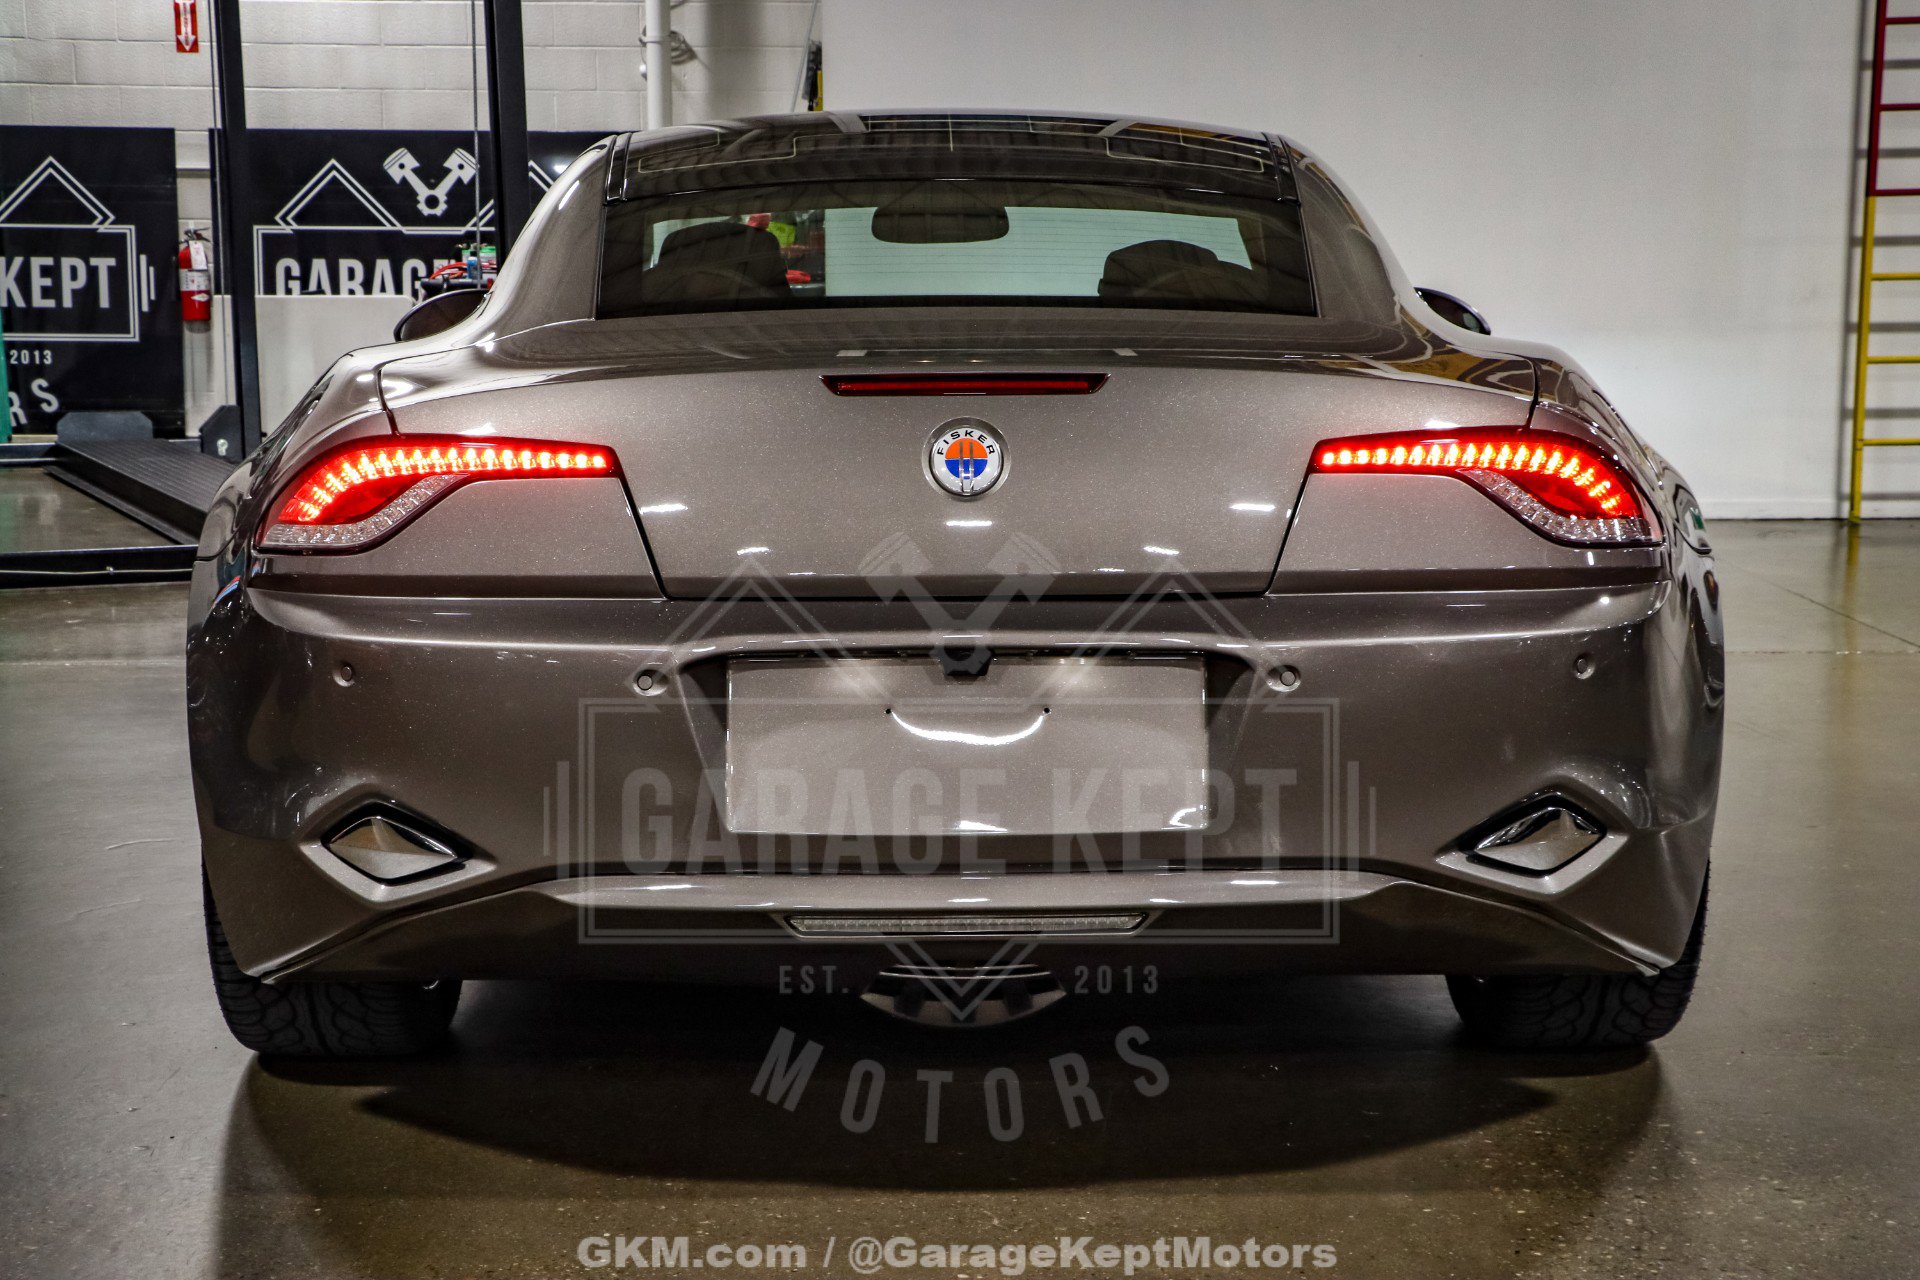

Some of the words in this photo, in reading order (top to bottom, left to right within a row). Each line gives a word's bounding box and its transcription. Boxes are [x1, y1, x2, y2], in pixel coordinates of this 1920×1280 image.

[0, 256, 117, 309] KEPT
[274, 257, 456, 297] GARAG
[9, 349, 53, 365] 2013
[937, 429, 996, 456] FISKER
